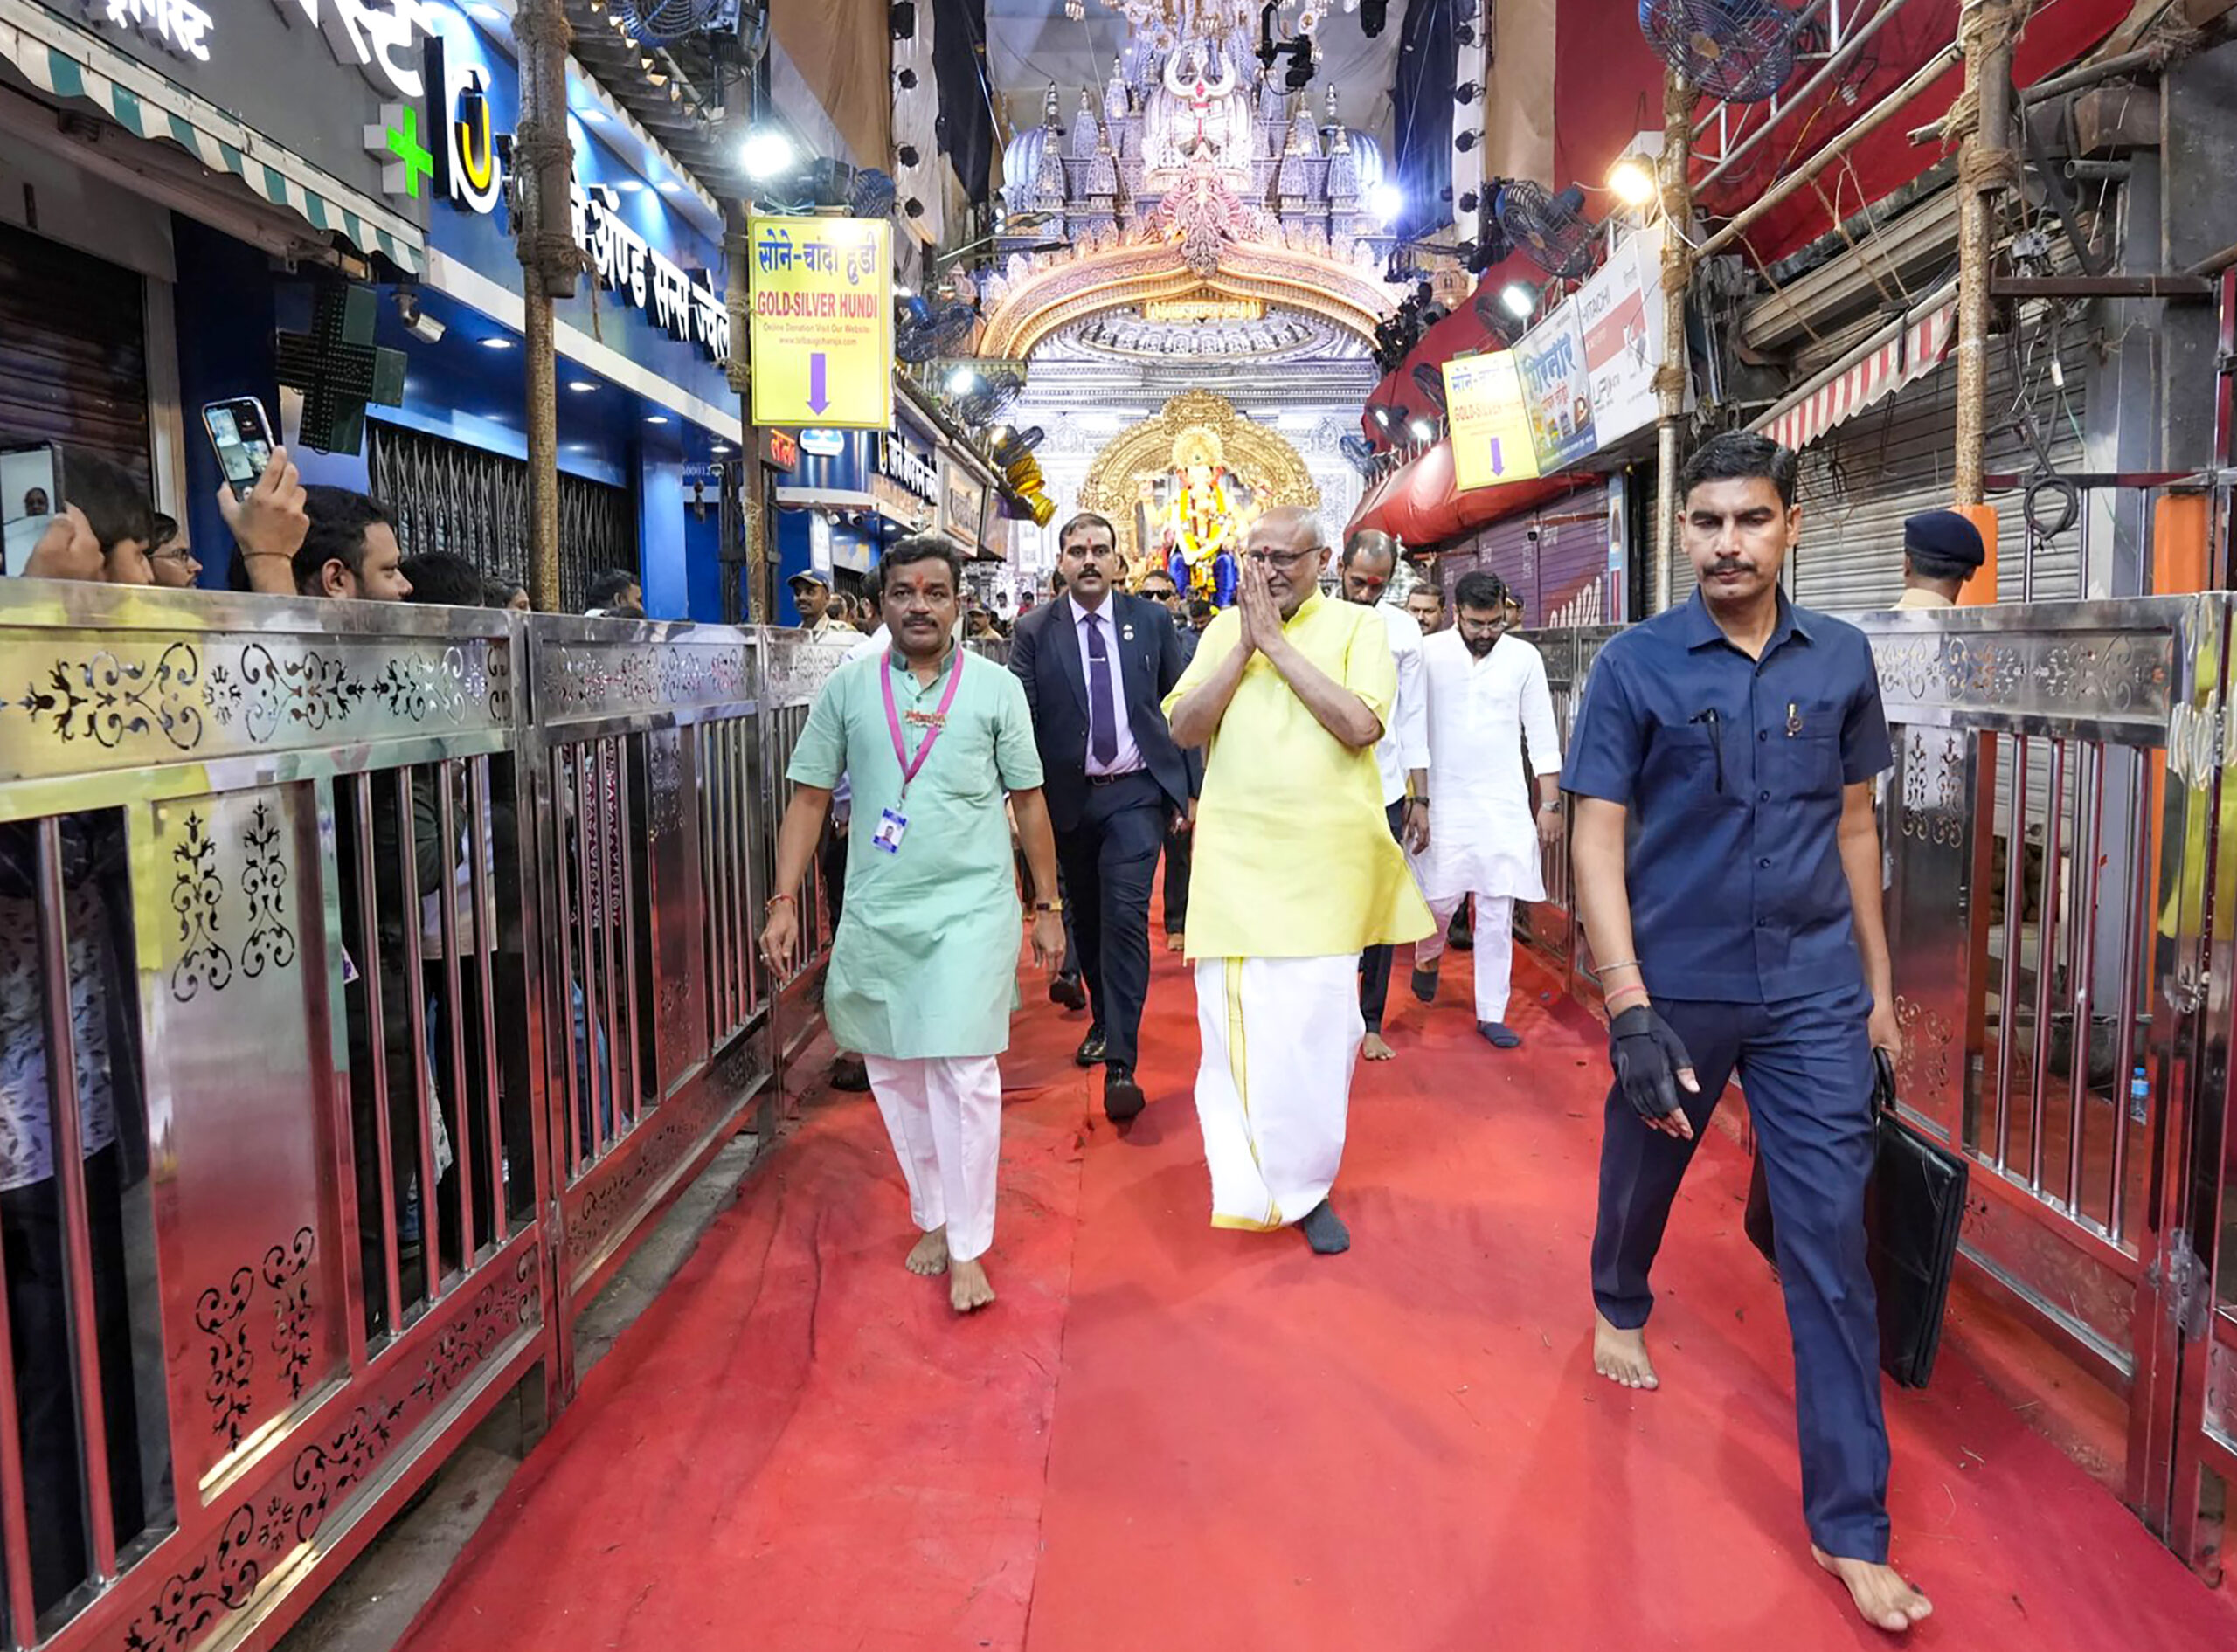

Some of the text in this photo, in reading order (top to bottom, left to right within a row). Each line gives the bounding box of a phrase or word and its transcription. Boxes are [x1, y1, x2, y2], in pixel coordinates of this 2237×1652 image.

[758, 291, 878, 319] GOLD-SILVER HUNDI
[1583, 285, 1610, 322] HITACHI
